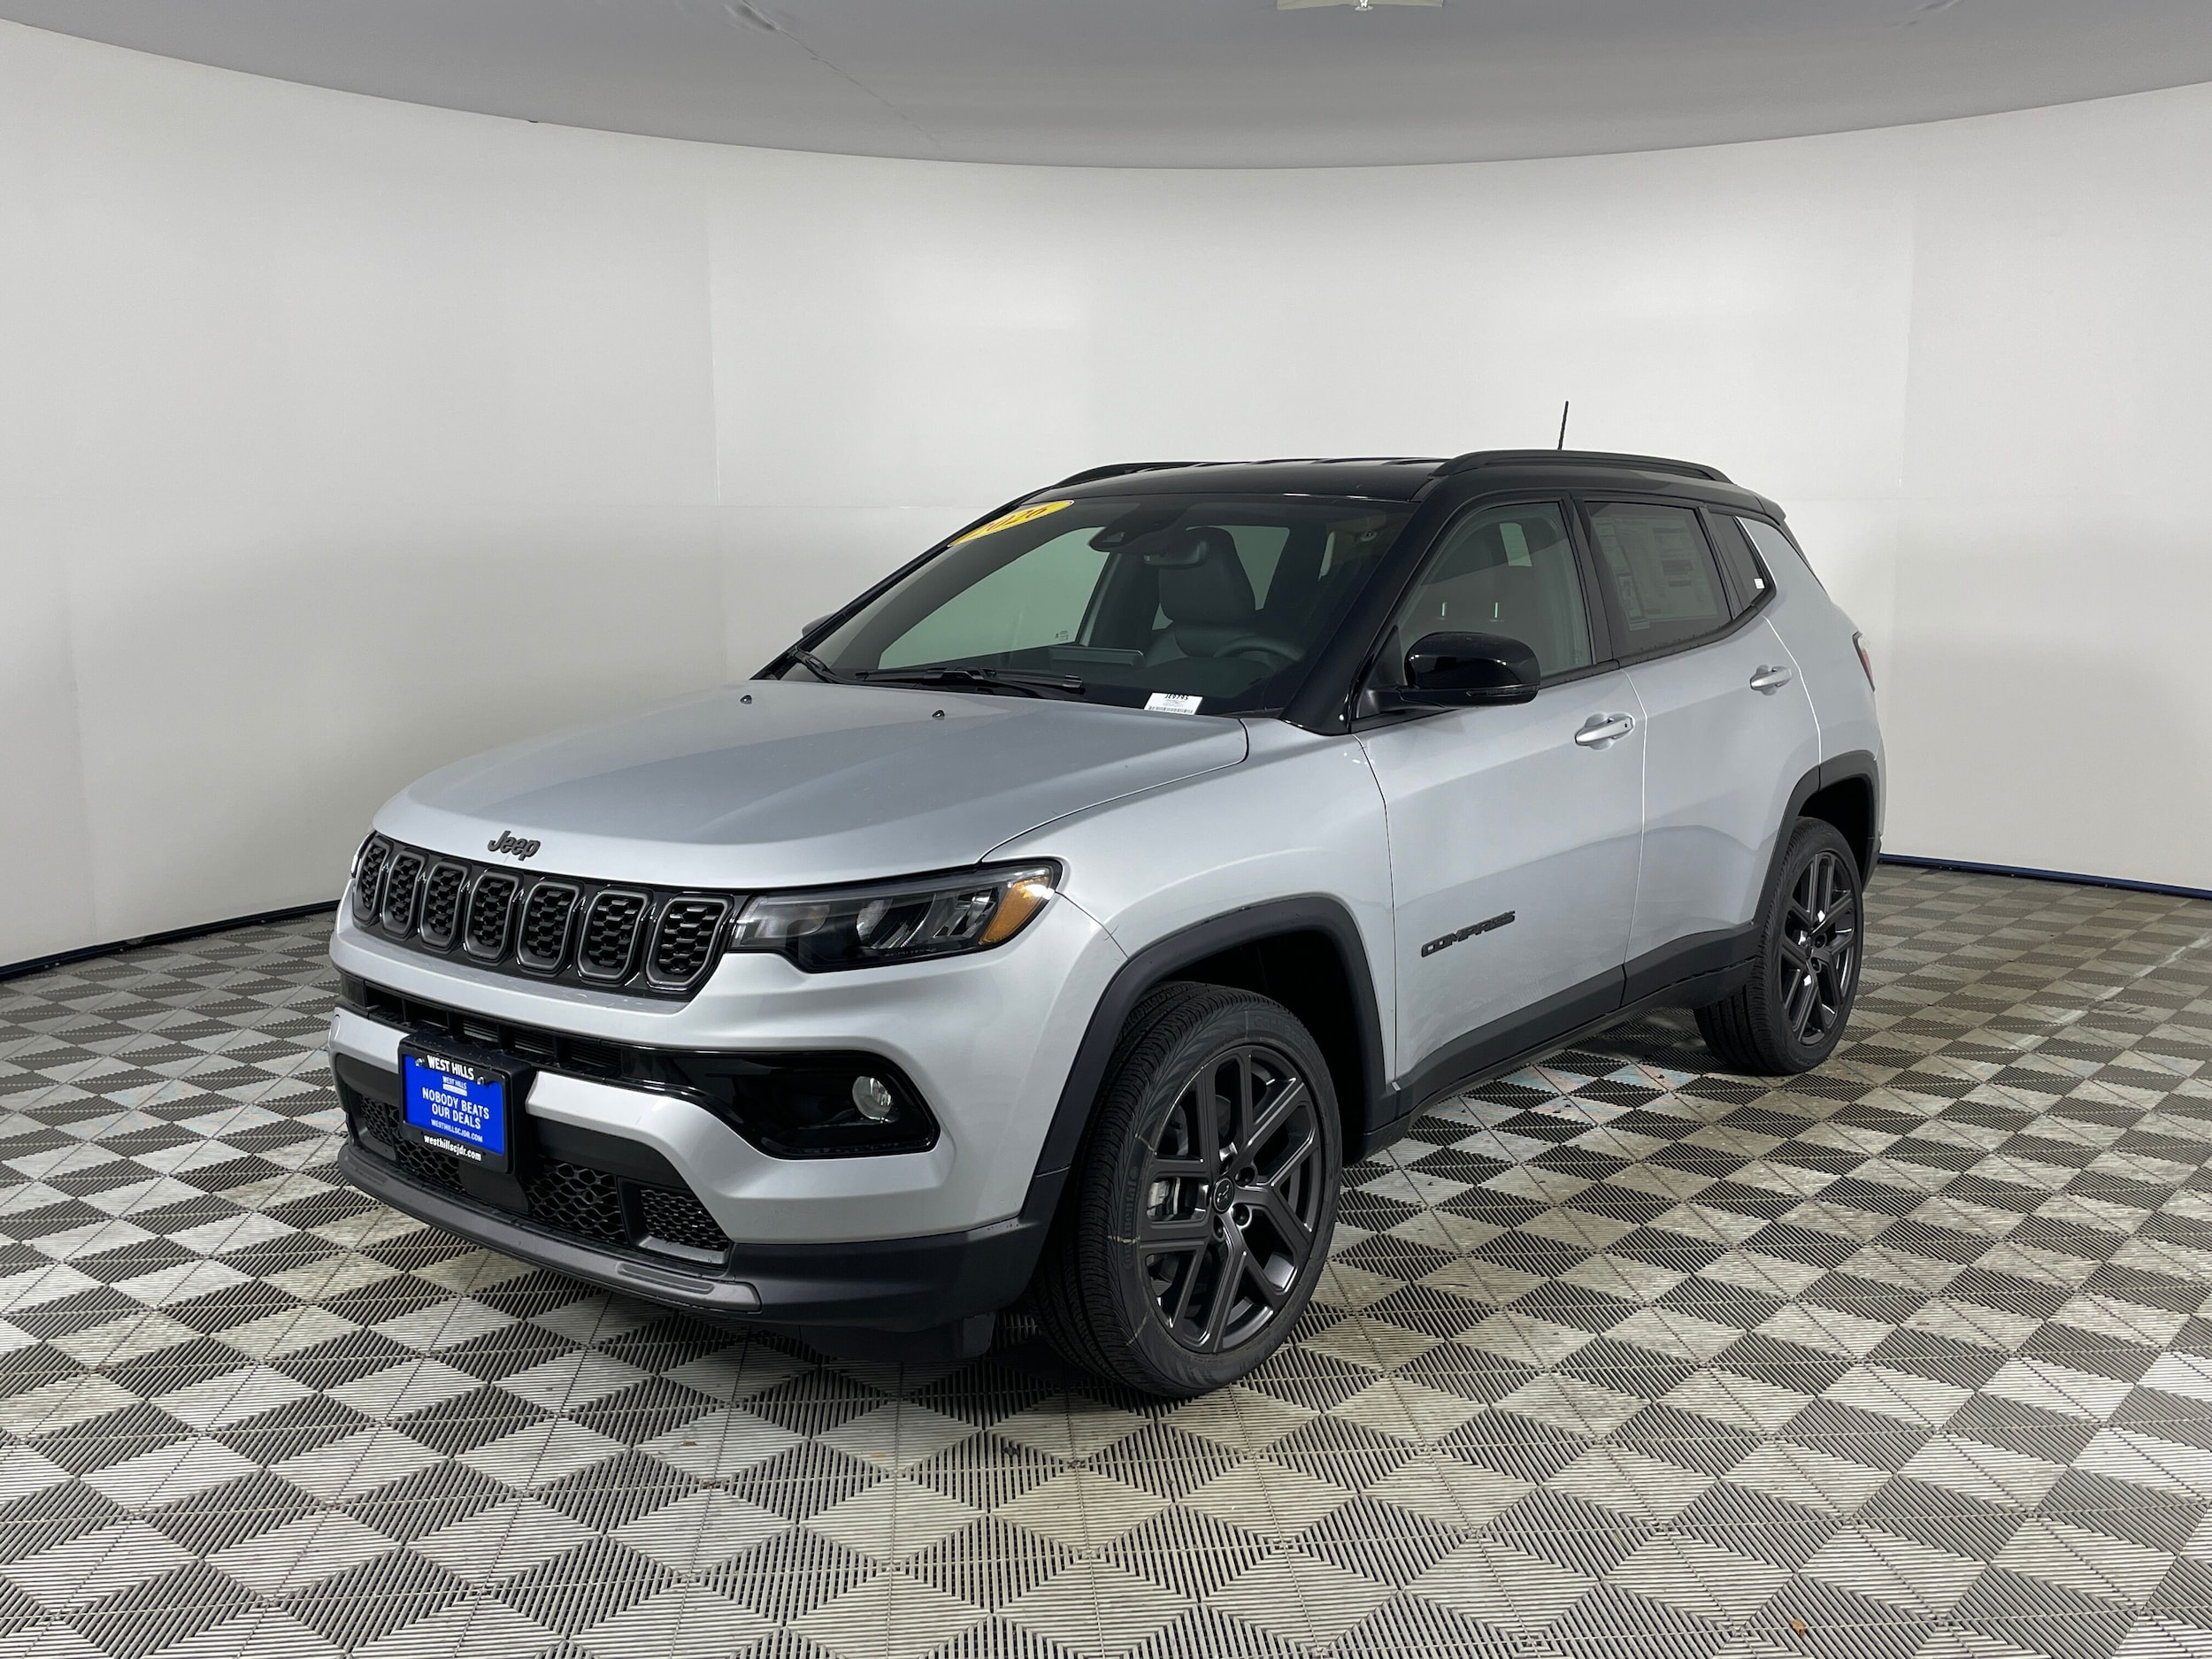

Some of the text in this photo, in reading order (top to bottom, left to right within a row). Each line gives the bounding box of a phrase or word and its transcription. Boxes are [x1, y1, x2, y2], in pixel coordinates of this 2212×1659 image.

[488, 830, 541, 862] Jeep
[1421, 910, 1516, 957] COMPASS
[426, 1055, 475, 1080] WEST HILLS
[442, 1076, 467, 1090] WEST HILLS
[422, 1087, 458, 1109] NOBODY
[461, 1100, 489, 1119] BEATS
[432, 1102, 481, 1129] OUR DEALS
[431, 1118, 483, 1142] WESTHILLSCJDR.COM
[424, 1134, 482, 1162] westhillscjdr.com
[1121, 1181, 1137, 1269] Coninental
